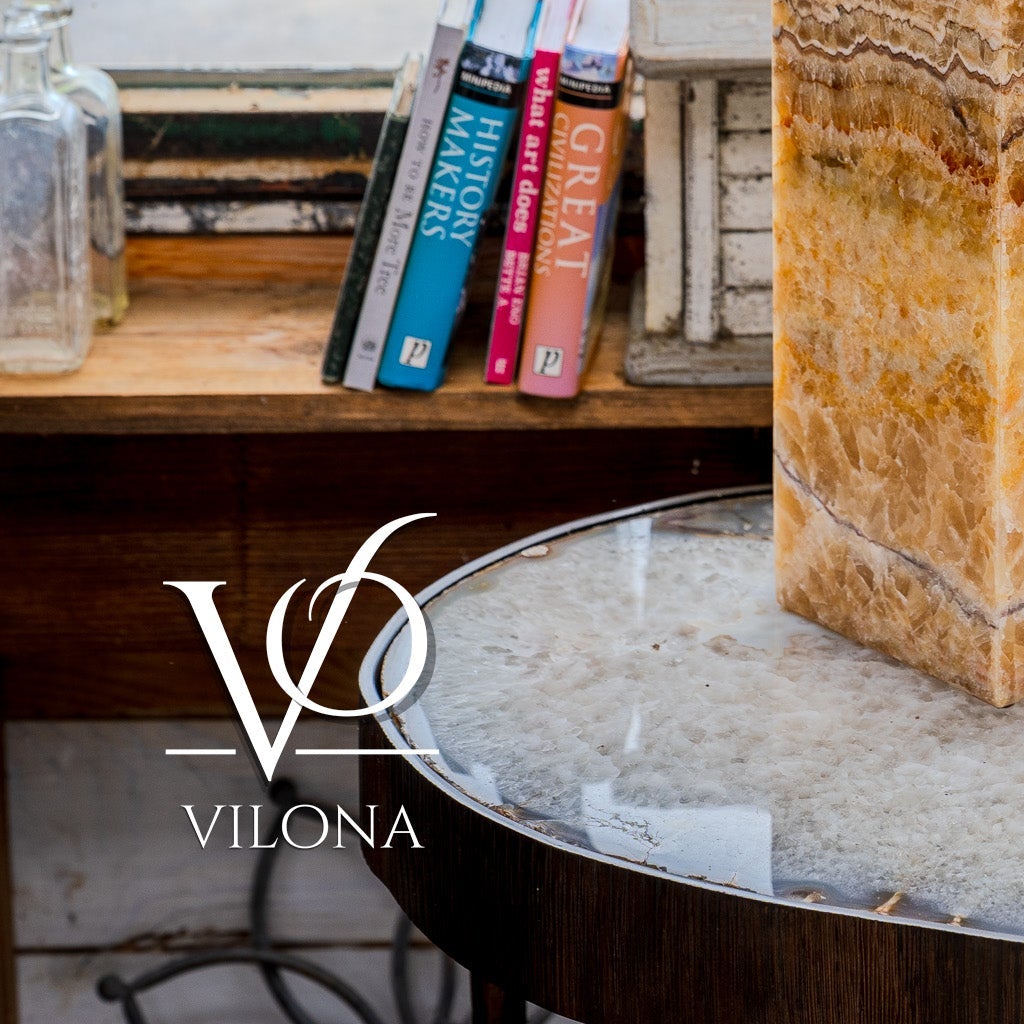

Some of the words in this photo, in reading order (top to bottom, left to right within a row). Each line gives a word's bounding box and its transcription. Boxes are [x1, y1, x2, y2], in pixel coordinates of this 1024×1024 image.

[461, 71, 513, 94] MINIPEDIA
[528, 67, 553, 128] what
[416, 118, 433, 154] HOW
[522, 134, 541, 173] art
[408, 159, 423, 180] TO
[421, 106, 474, 240] MAKERS
[450, 117, 504, 247] HISTORY
[513, 179, 540, 234] does
[534, 112, 571, 276] CIVILIZATIONS
[555, 122, 606, 279] GREAT
[385, 208, 413, 255] More
[375, 260, 401, 296] Tree
[513, 252, 530, 295] BRIAN
[509, 298, 524, 326] ENO
